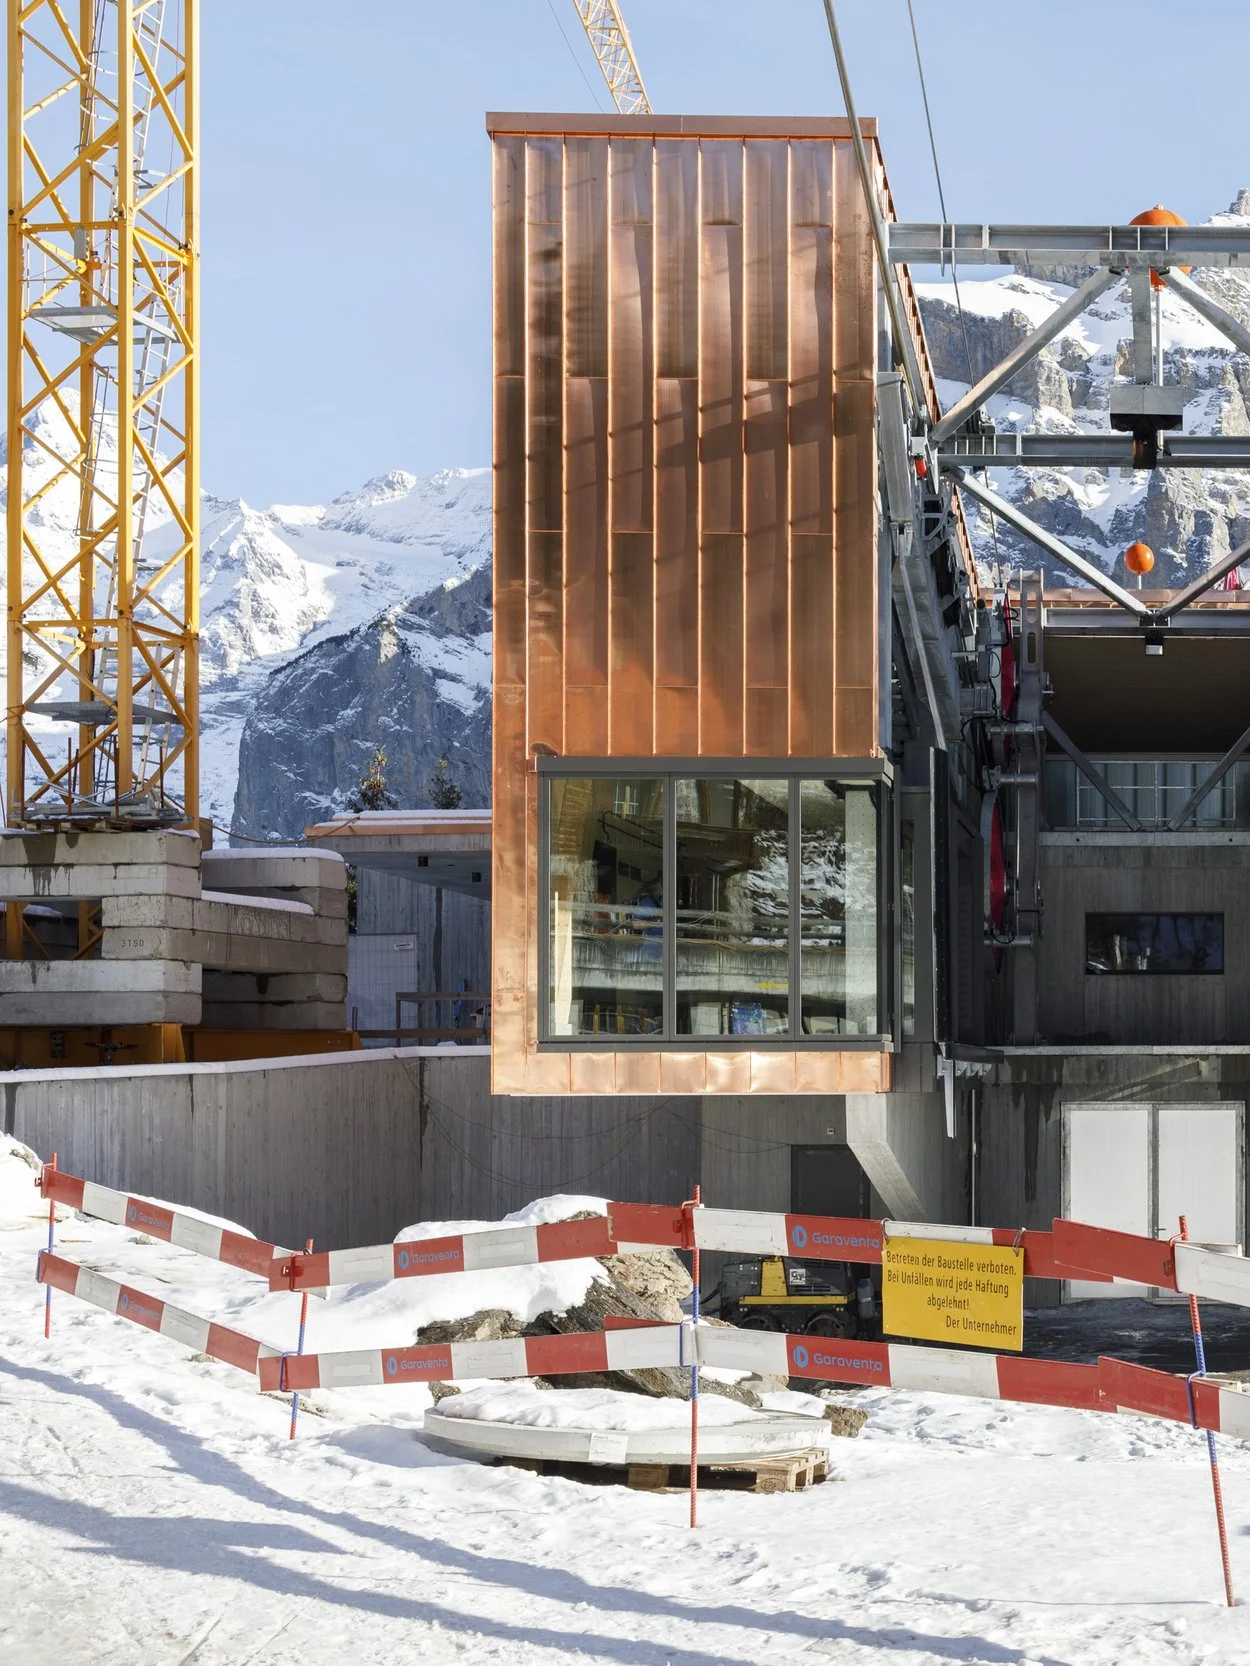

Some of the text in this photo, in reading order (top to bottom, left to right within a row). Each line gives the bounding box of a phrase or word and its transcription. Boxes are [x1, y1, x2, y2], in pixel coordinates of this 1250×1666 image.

[120, 939, 144, 948] 3150
[138, 1212, 170, 1230] Garaventa
[812, 1232, 880, 1249] Garaventa
[412, 1249, 460, 1264] Garaventa
[886, 1251, 1017, 1275] Betreten der Baustelle verboten.
[887, 1270, 1009, 1298] Bei Unfällen wird jede Haftung
[927, 1293, 969, 1311] abgelehnt!
[946, 1315, 1017, 1336] Der Unternehmer
[400, 1359, 448, 1370] Garaventa
[813, 1353, 883, 1372] Garaventa
